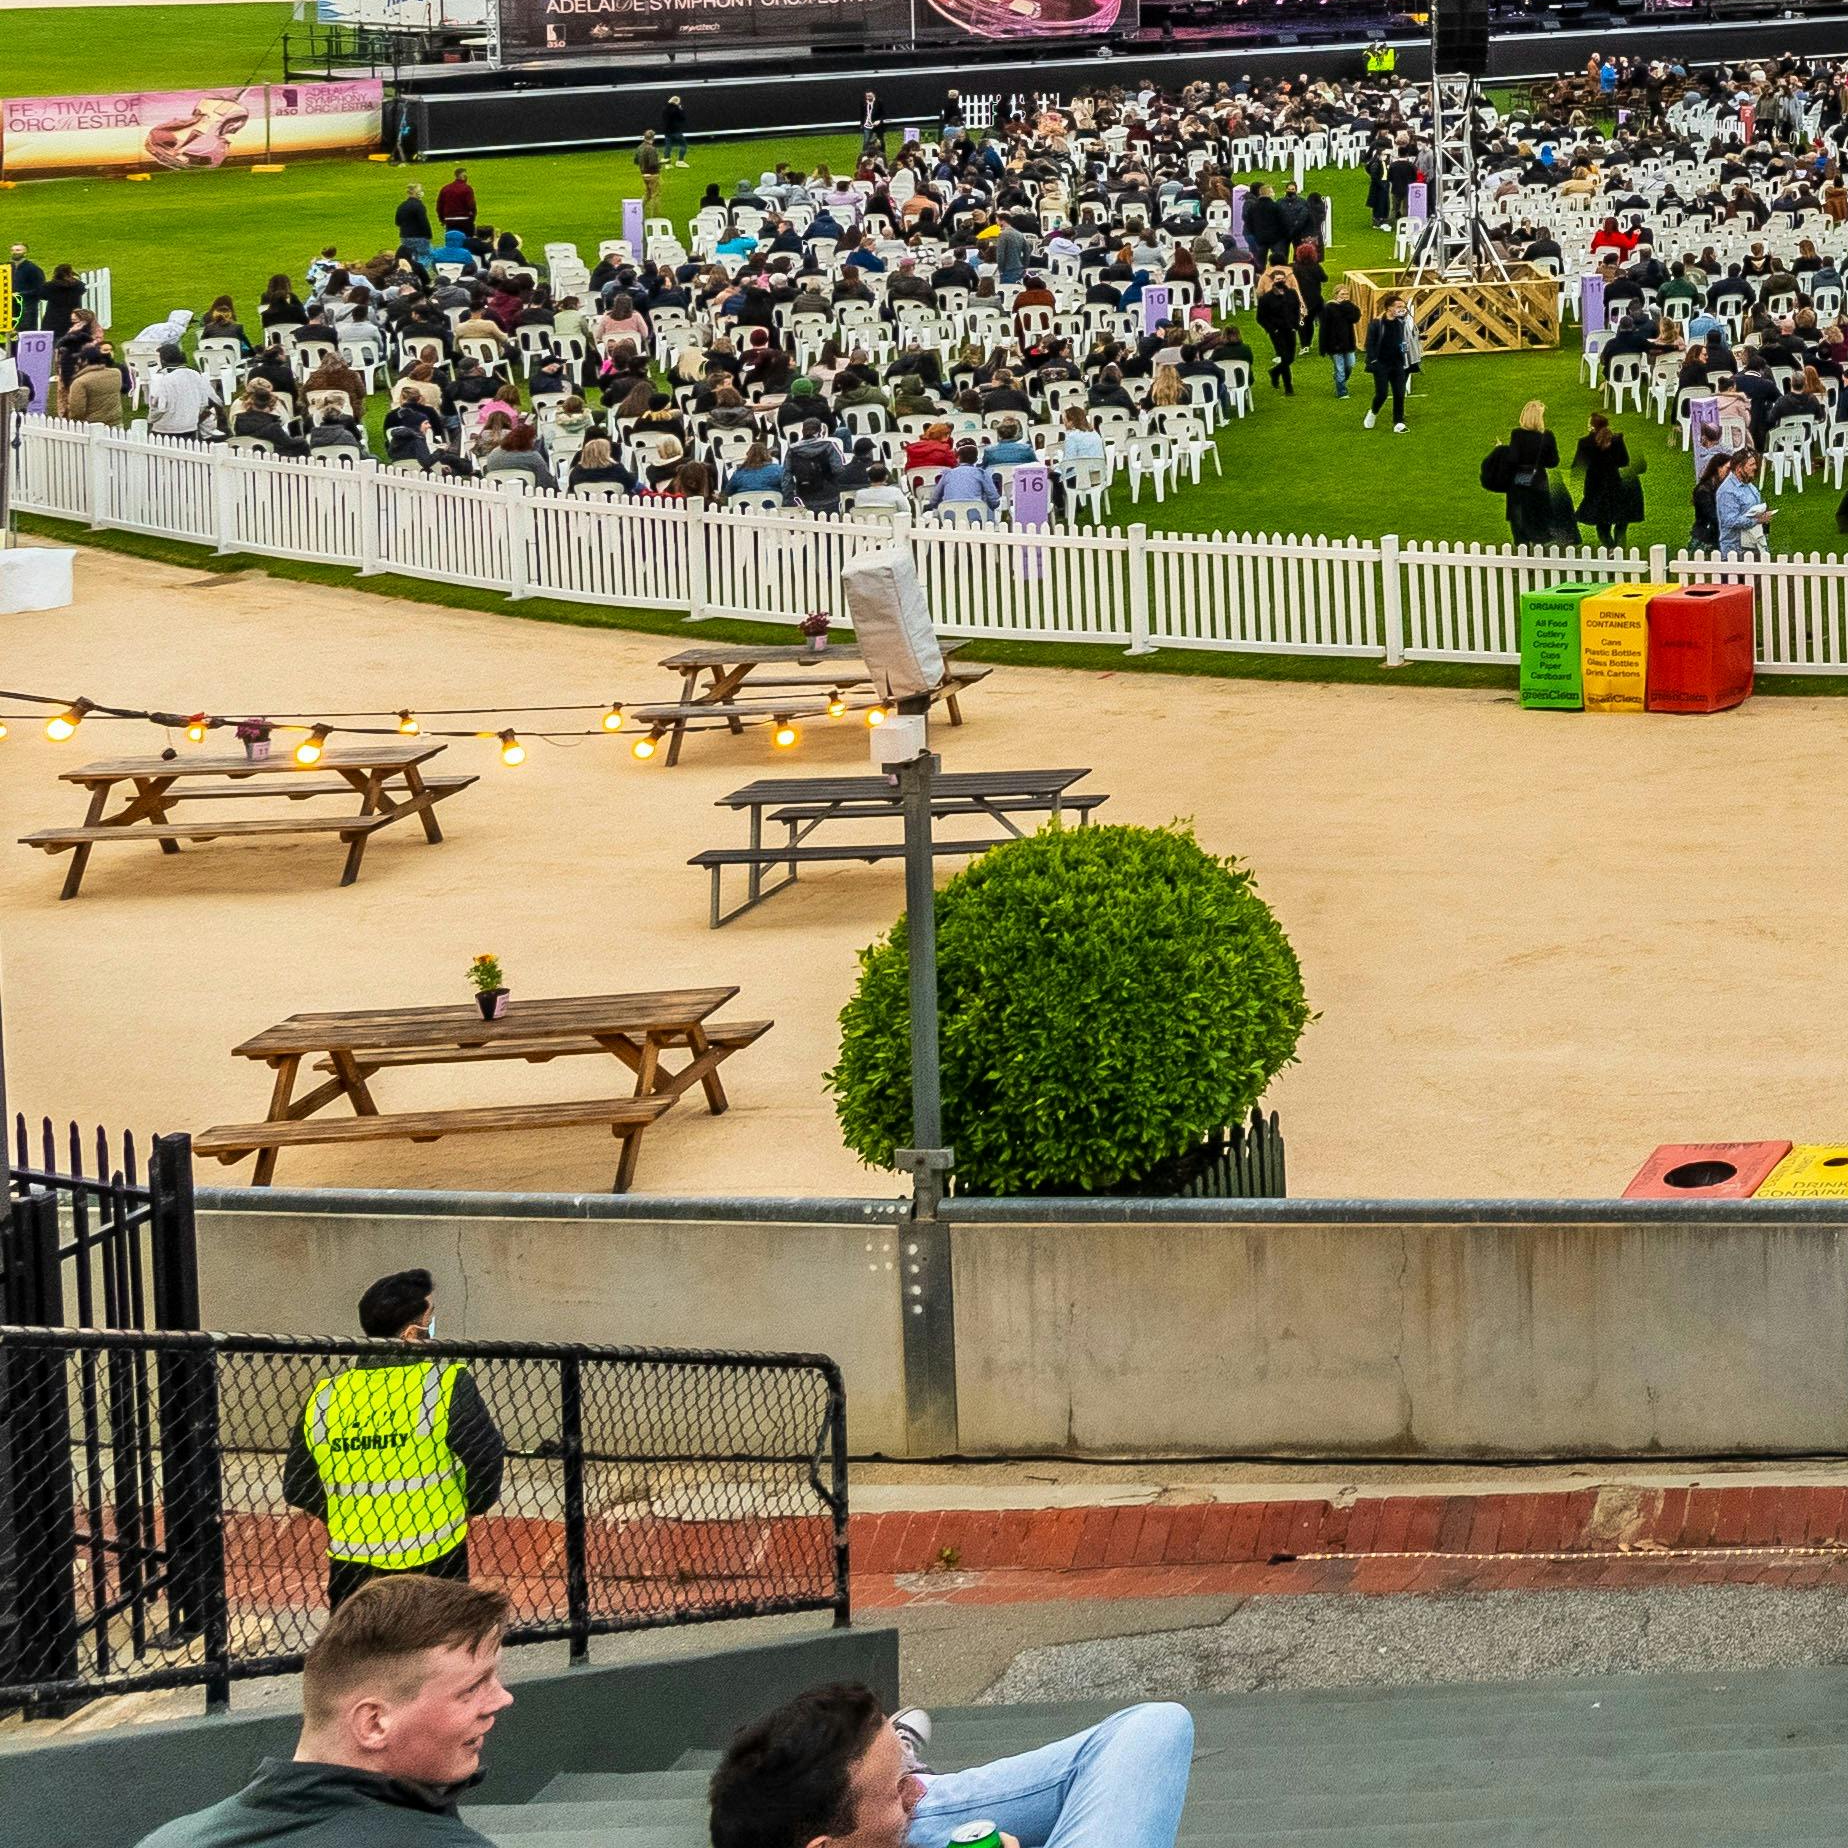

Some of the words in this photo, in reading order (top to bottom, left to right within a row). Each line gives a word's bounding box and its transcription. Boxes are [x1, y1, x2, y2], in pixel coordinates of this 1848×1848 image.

[113, 98, 140, 114] OF
[1149, 293, 1166, 304] 10
[25, 341, 46, 353] 10
[1019, 477, 1044, 493] 16
[1529, 602, 1575, 611] ORGANICS
[1600, 611, 1627, 619] DRINK
[1535, 619, 1547, 627] All
[1548, 619, 1568, 627] Food
[1585, 620, 1642, 629] CONTAINERS
[1601, 638, 1622, 646] Cans
[331, 1433, 408, 1452] SECURITY
